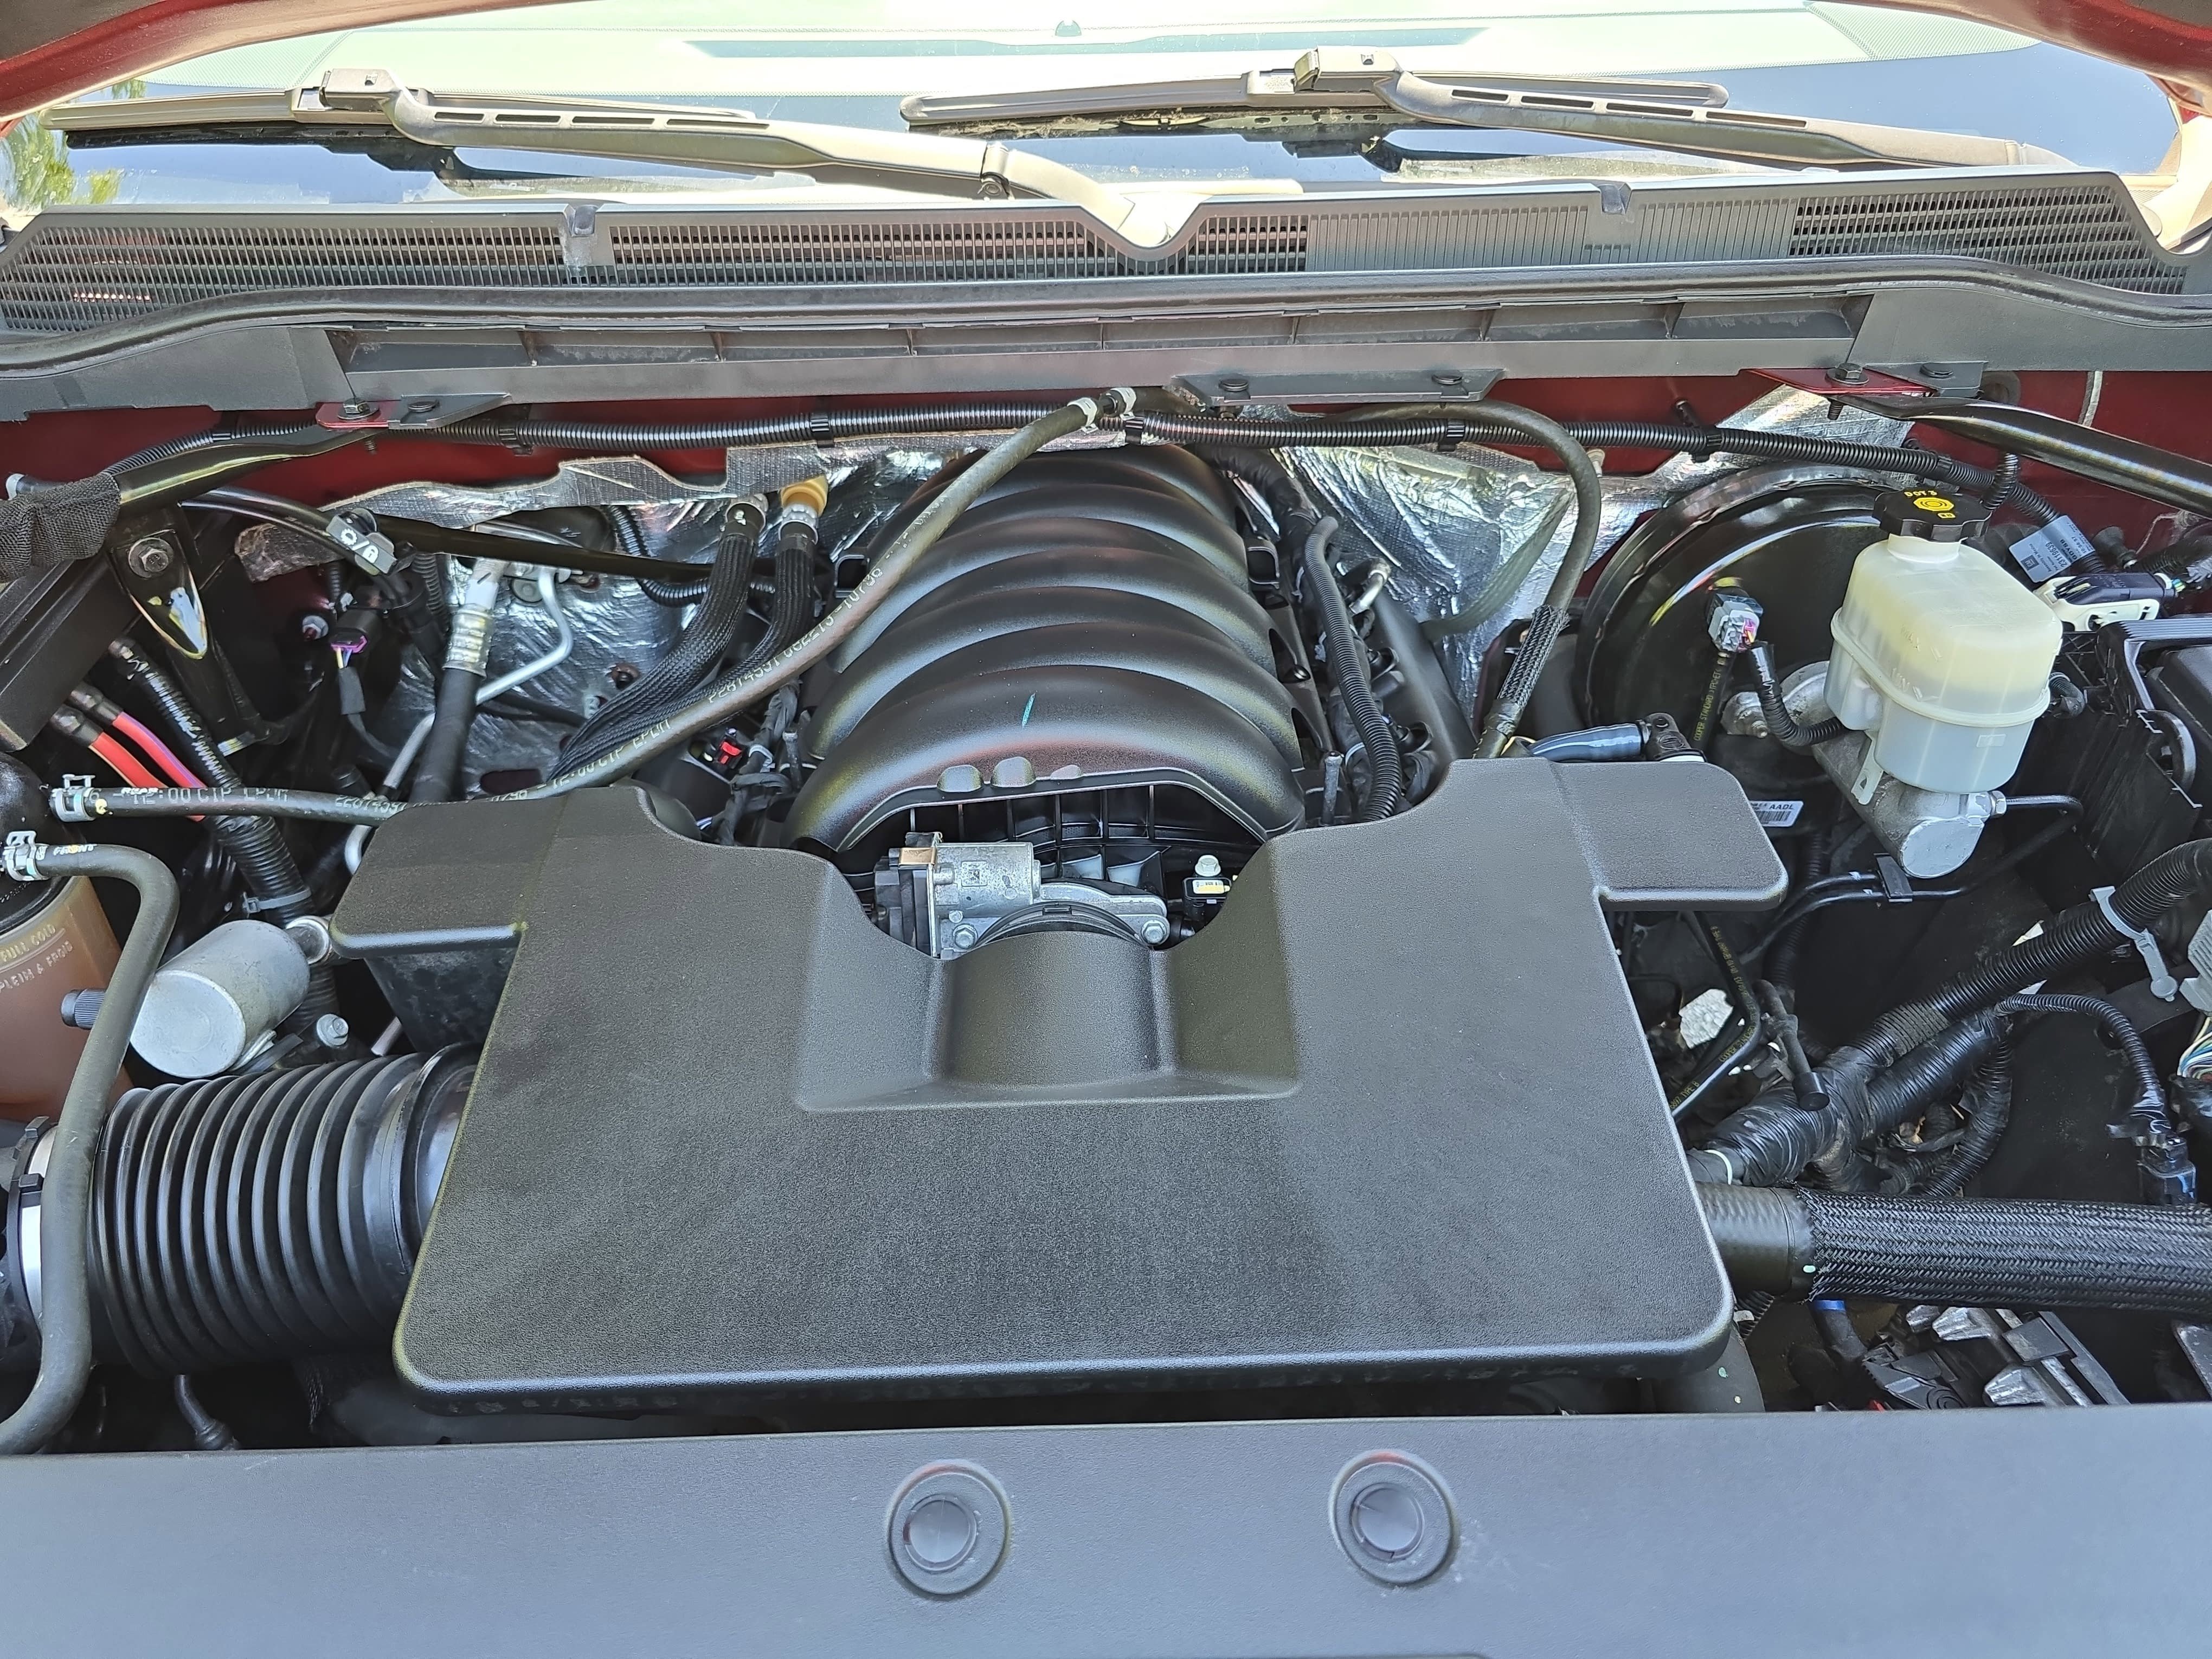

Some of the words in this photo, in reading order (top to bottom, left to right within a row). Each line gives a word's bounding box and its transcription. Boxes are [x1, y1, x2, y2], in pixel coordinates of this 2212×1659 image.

[1693, 722, 1705, 741] COOPER
[1699, 695, 1714, 721] STANDARD
[0, 942, 30, 962] FULL
[30, 923, 56, 946] COLD
